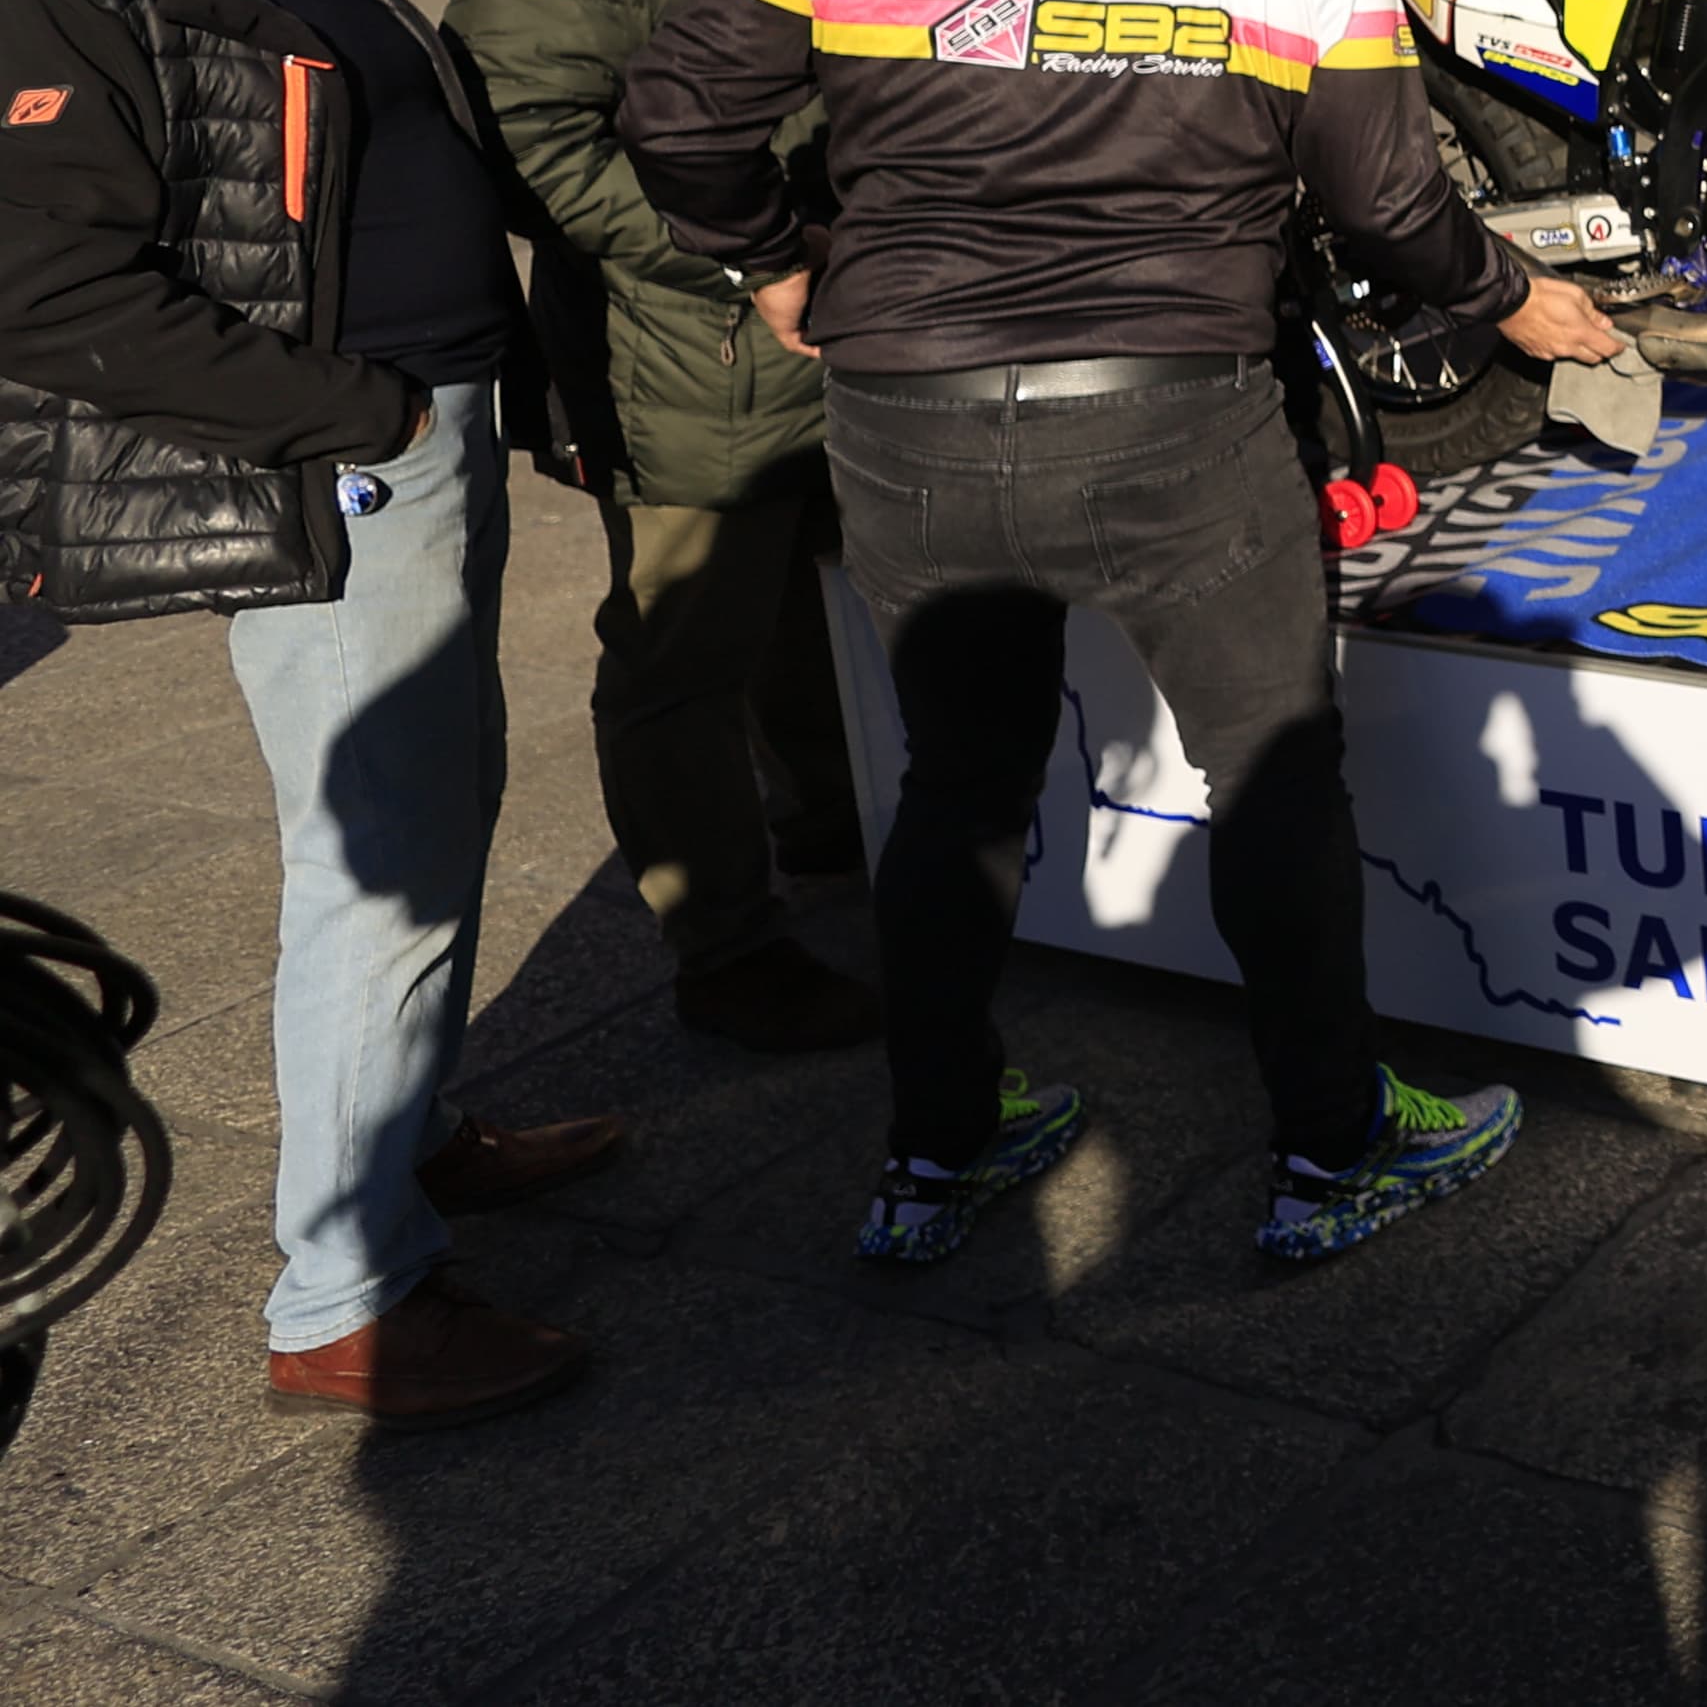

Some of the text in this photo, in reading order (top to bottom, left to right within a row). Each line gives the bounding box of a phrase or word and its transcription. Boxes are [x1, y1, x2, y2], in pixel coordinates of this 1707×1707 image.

[1477, 33, 1511, 51] TVS
[1042, 52, 1224, 78] Racing Service
